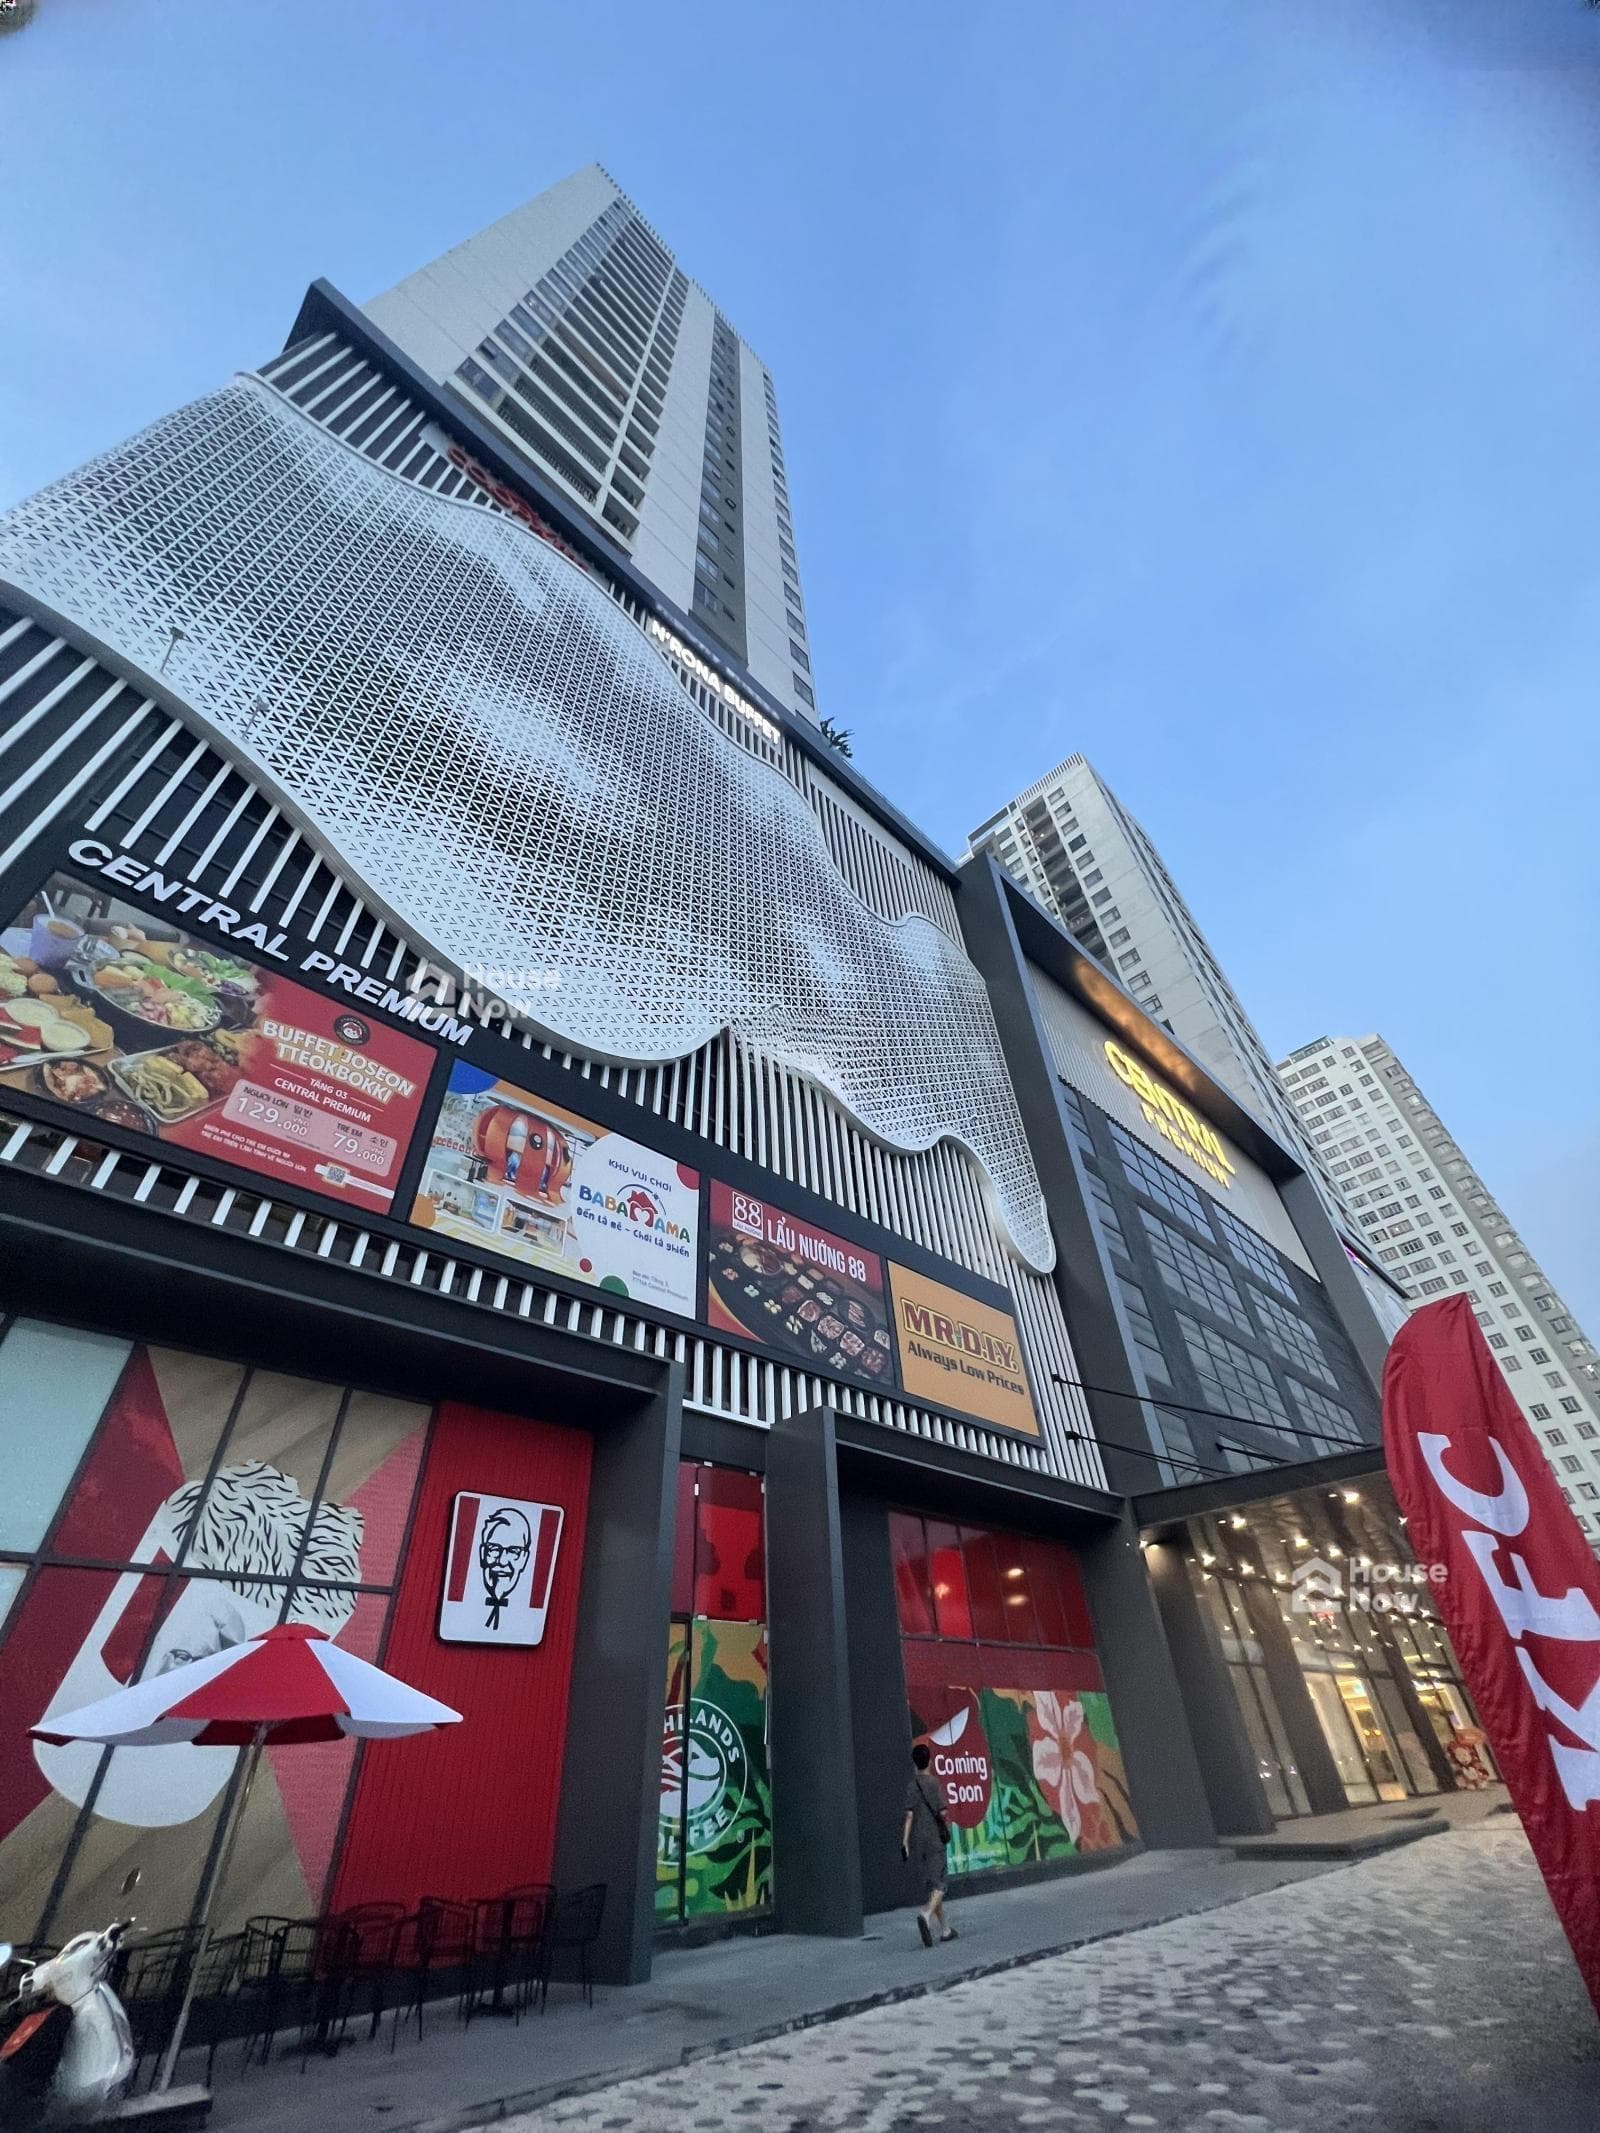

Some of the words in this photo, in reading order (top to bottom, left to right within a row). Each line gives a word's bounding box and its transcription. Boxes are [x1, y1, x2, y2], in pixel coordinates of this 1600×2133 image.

[724, 684, 781, 744] BUFFET
[68, 839, 289, 961] CENTRAL
[299, 950, 474, 1047] PREMIUM
[263, 1020, 338, 1057] BUFFET
[340, 1049, 415, 1097] JOSEON
[277, 1042, 393, 1103] TTEOKBOKKI
[274, 1077, 320, 1102] CENTRAL
[323, 1097, 372, 1122] PREMIUM
[335, 1089, 348, 1100] 03
[1104, 1040, 1236, 1175] CENTRAL
[334, 1131, 385, 1165] 79.000
[609, 1159, 629, 1173] KHU
[632, 1168, 647, 1181] VUI
[1140, 1102, 1231, 1190] PREMIUM
[734, 1196, 761, 1227] 88
[767, 1216, 796, 1252] LẨU
[799, 1234, 846, 1274] NƯỚNG
[848, 1256, 867, 1282] 88
[908, 1340, 958, 1372] Always
[959, 1359, 985, 1381] Low
[987, 1369, 1024, 1395] Prices
[1417, 1432, 1600, 1811] KFC
[934, 1750, 988, 1781] Coming
[946, 1782, 984, 1804] Soon
